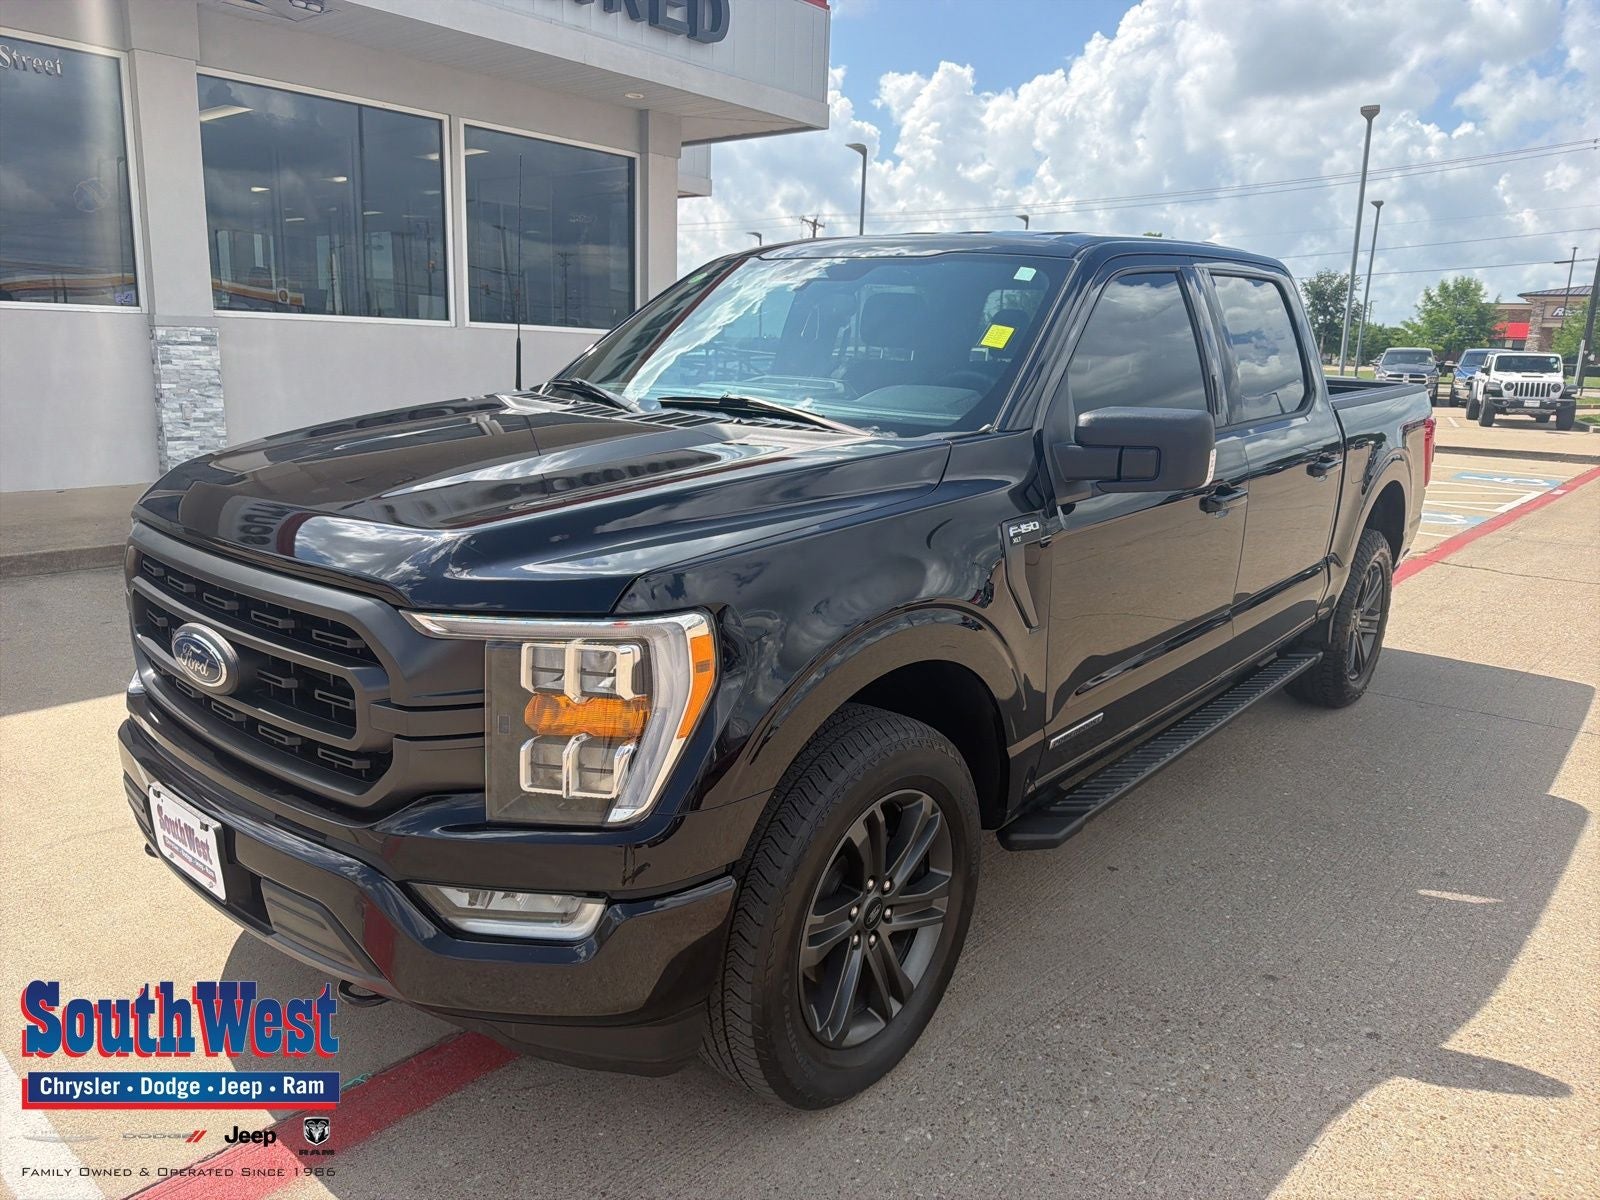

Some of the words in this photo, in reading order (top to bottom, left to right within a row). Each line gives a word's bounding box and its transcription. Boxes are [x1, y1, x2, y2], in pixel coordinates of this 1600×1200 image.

[0, 44, 63, 78] Street
[1008, 521, 1040, 537] F-150
[1012, 536, 1022, 544] XLT
[179, 642, 210, 677] Ford
